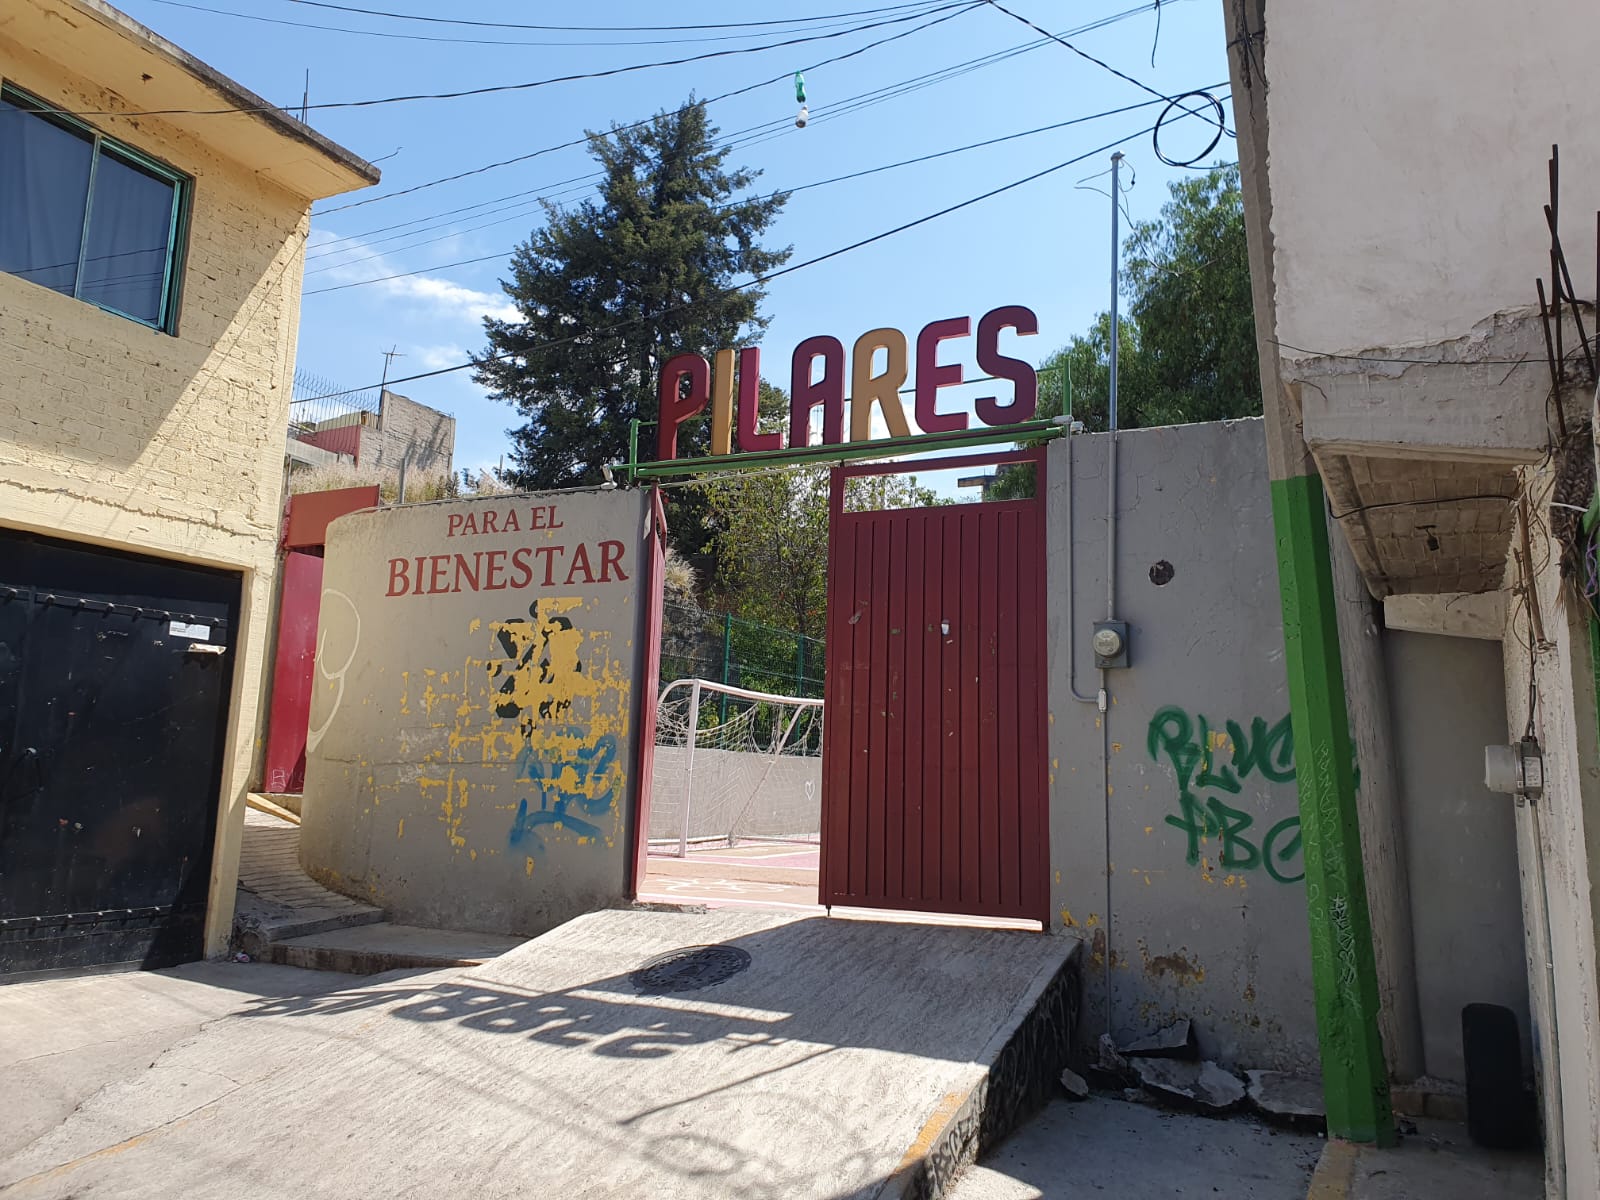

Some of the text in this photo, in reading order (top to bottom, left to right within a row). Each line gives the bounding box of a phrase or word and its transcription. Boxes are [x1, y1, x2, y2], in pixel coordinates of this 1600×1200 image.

[658, 305, 1039, 460] PILARES
[447, 505, 564, 537] PARA EL
[385, 540, 629, 597] BIENESTAR
